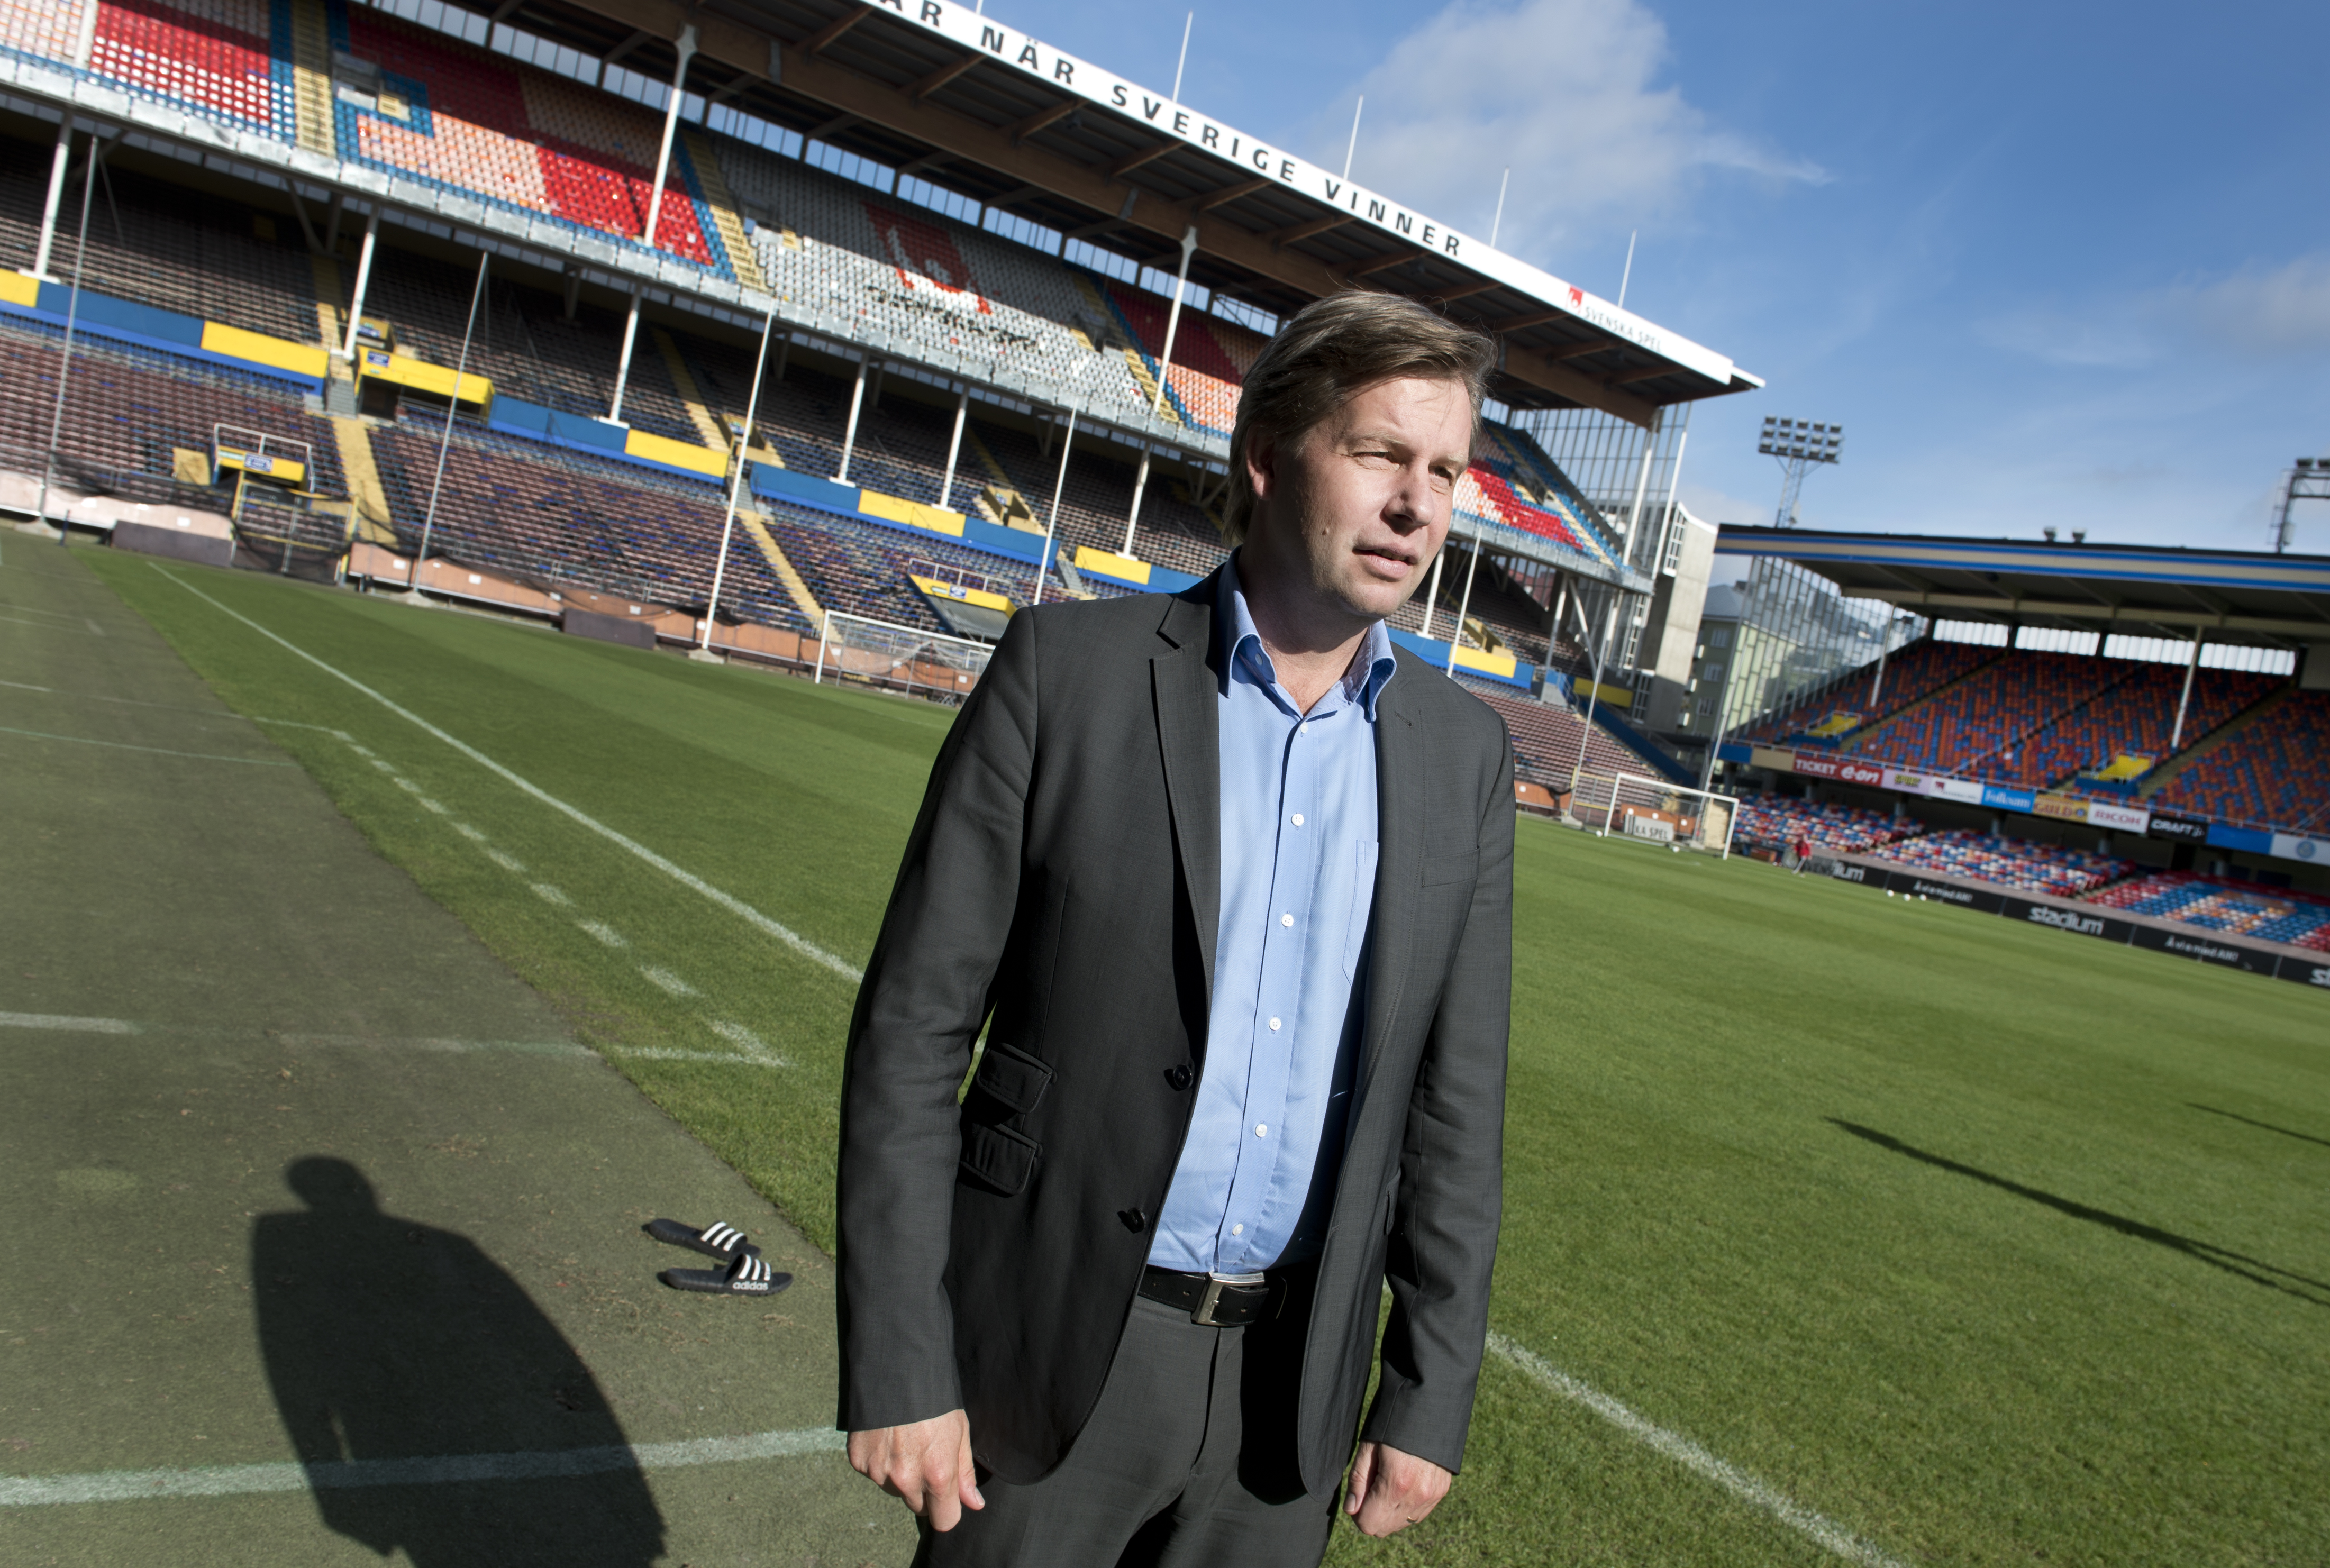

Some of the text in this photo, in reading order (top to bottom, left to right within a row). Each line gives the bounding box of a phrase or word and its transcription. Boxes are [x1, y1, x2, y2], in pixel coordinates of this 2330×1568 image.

[980, 25, 1075, 85] NÄR
[1112, 84, 1295, 183] SVERIGE
[1325, 178, 1460, 256] VINNER
[1585, 306, 1661, 353] SVENSKA SPEL
[1796, 759, 1837, 775] TICKET
[2034, 802, 2073, 818] GULD
[2094, 809, 2141, 825] RICOH
[1650, 826, 1667, 840] SPEL
[2151, 819, 2195, 835] CRAFT
[2028, 906, 2104, 935] stadium
[733, 1281, 768, 1291] adidas
